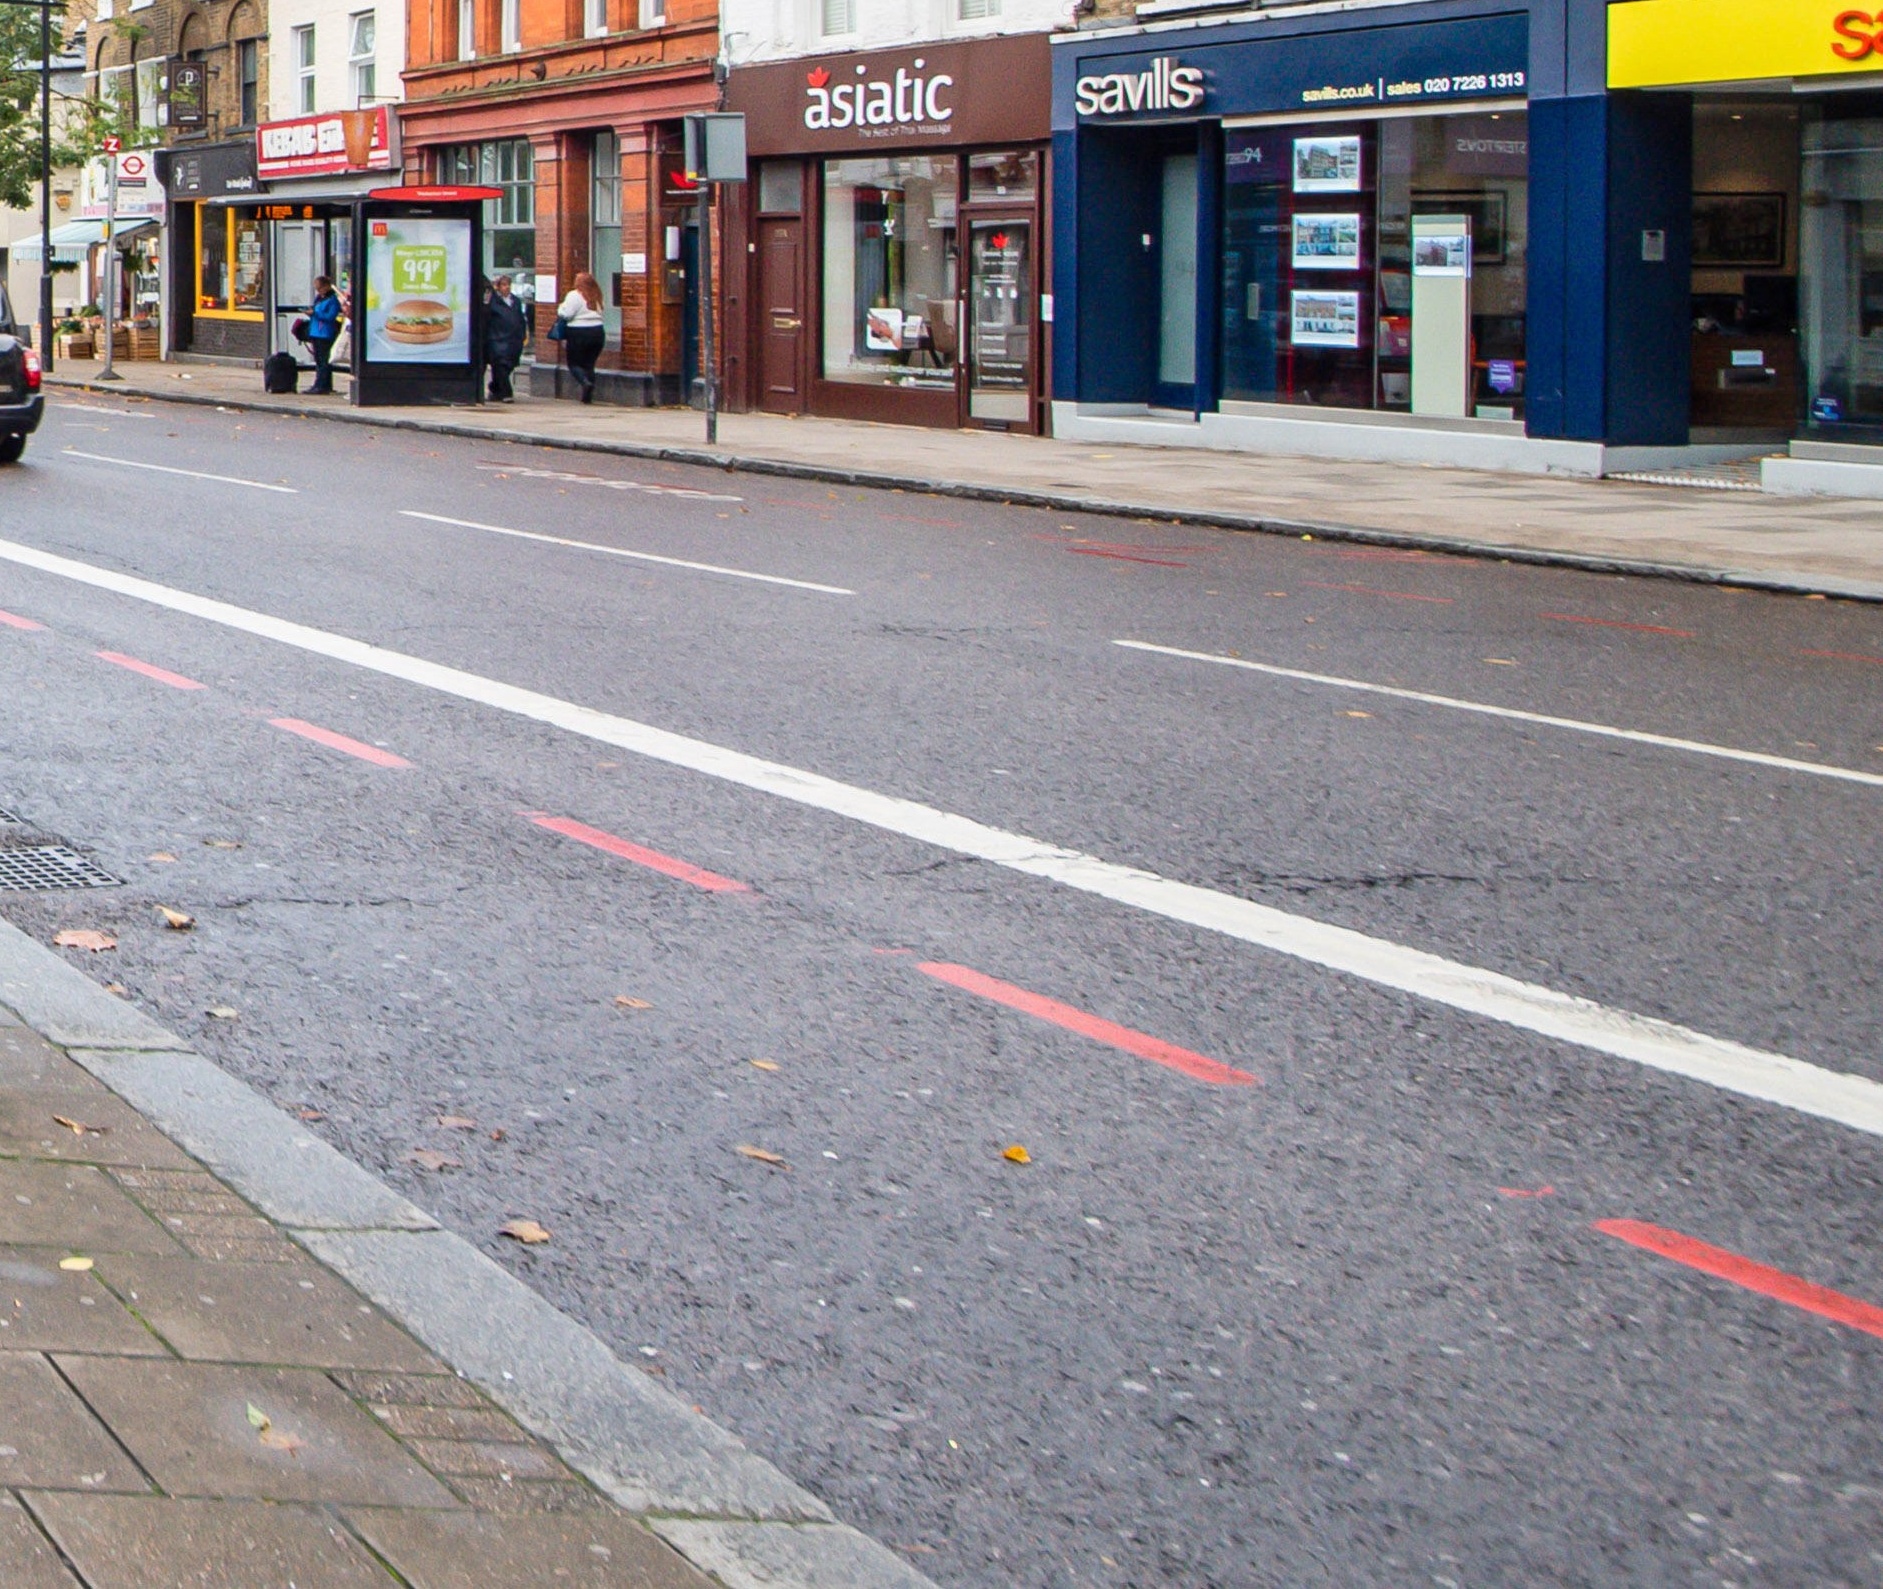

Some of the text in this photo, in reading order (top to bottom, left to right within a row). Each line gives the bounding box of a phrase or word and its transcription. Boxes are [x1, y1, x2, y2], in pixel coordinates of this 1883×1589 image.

[804, 58, 953, 130] asiatic
[1075, 57, 1204, 116] savills
[1302, 72, 1525, 102] savills.co.uk sales 020 7226 1313
[107, 138, 118, 151] Z
